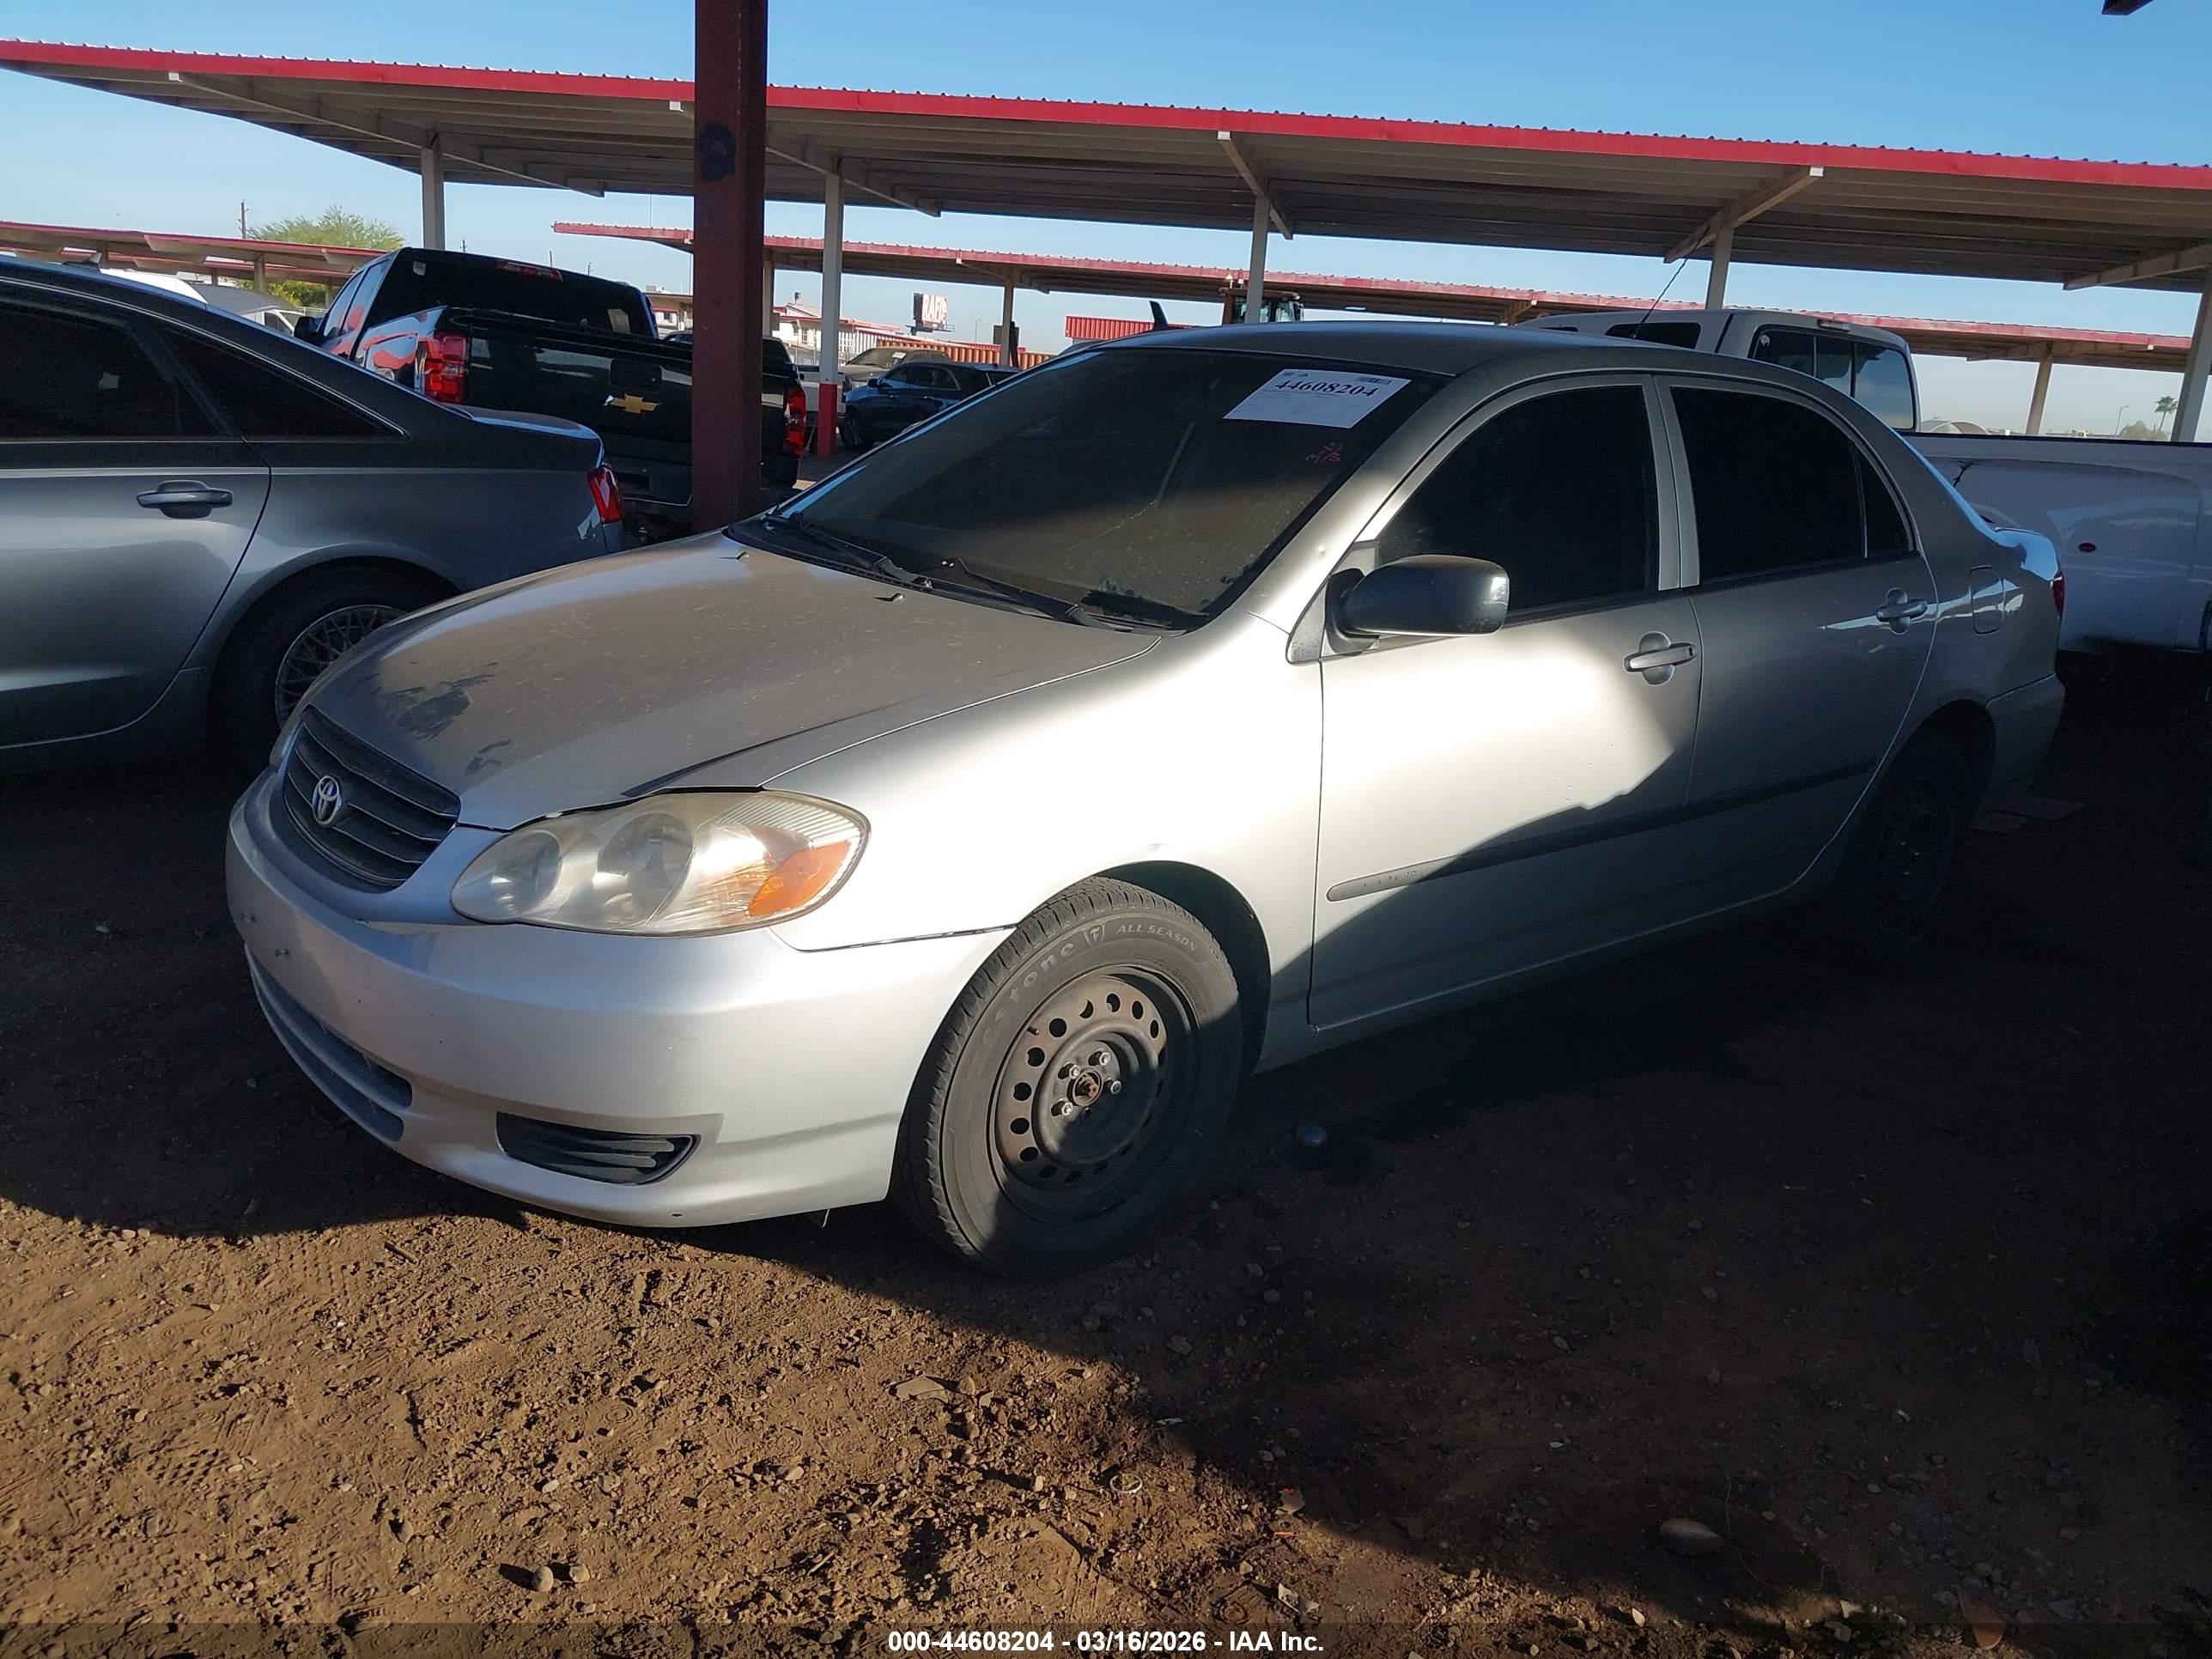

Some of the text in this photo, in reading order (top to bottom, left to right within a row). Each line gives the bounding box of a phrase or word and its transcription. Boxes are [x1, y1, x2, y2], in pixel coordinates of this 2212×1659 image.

[1275, 380, 1379, 397] 44608204
[1116, 924, 1144, 935] ALL
[1148, 925, 1198, 951] SEASON
